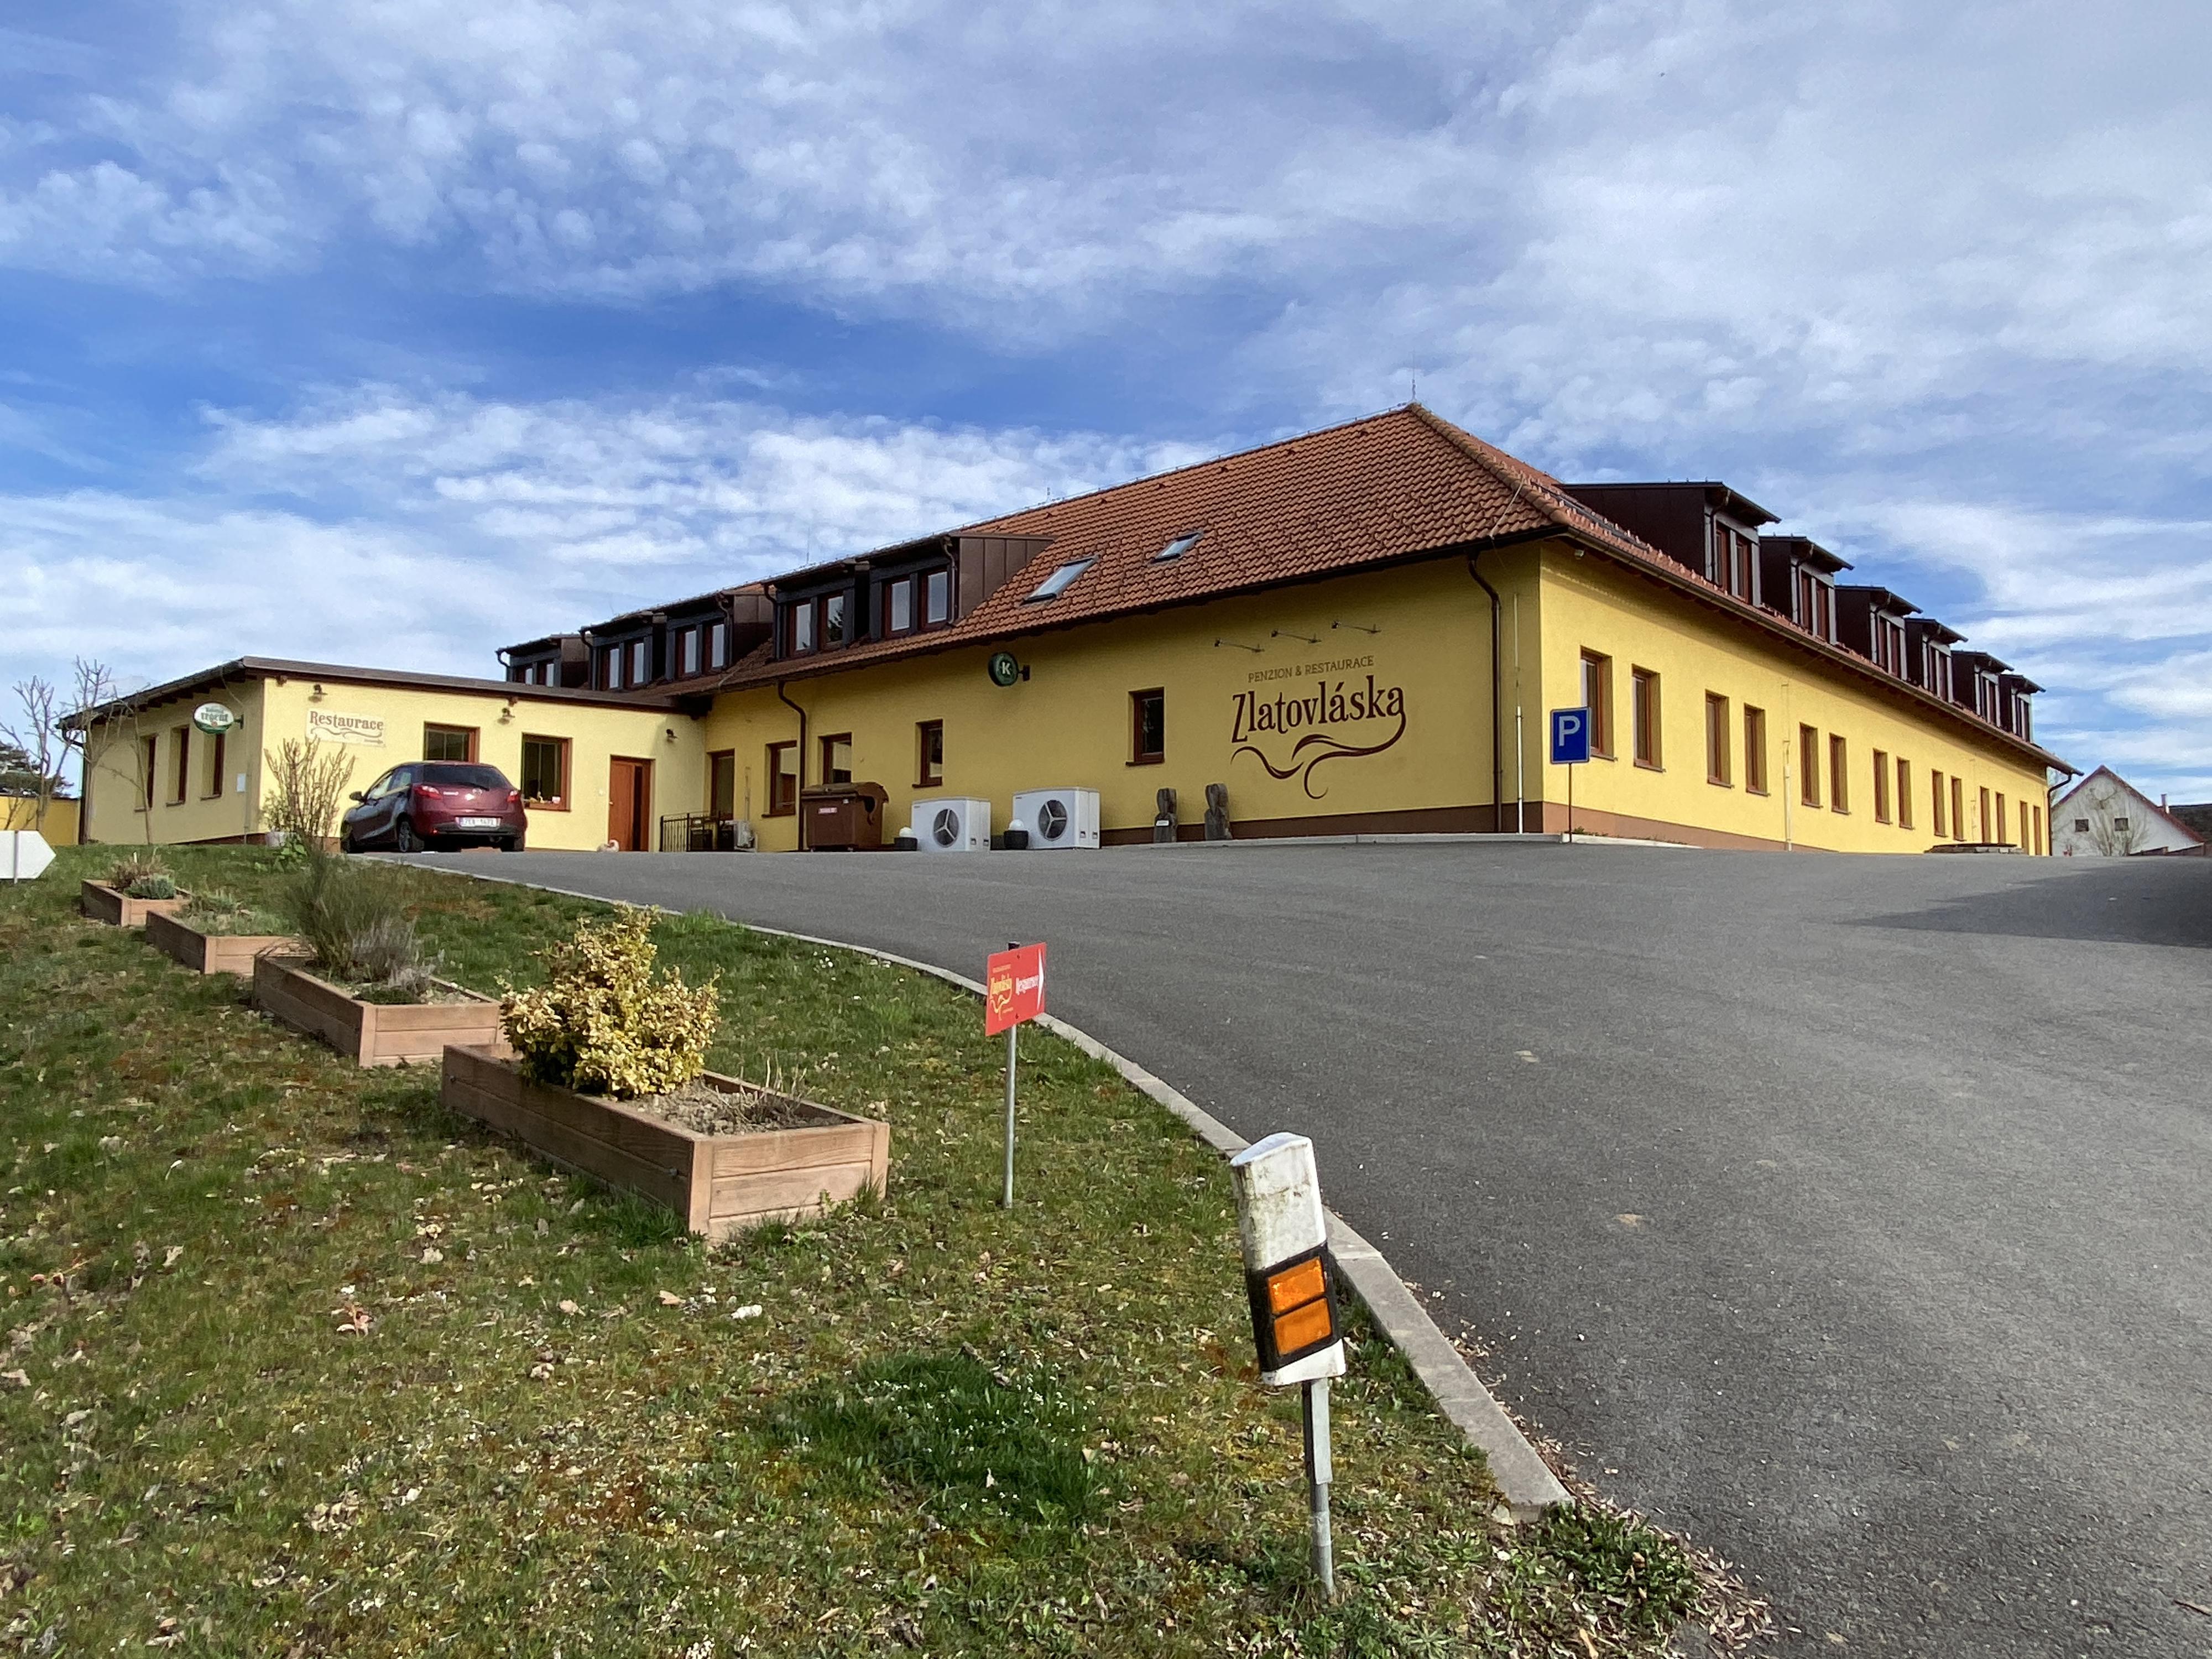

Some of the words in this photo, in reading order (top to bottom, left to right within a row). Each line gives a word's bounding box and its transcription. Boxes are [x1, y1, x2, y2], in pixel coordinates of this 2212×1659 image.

[1248, 667, 1293, 683] PENZION
[1295, 665, 1302, 676] &
[1305, 655, 1374, 675] RESTAURACE
[310, 711, 384, 731] Restaurace
[1231, 675, 1405, 743] Zlatovláska
[1558, 715, 1580, 747] P
